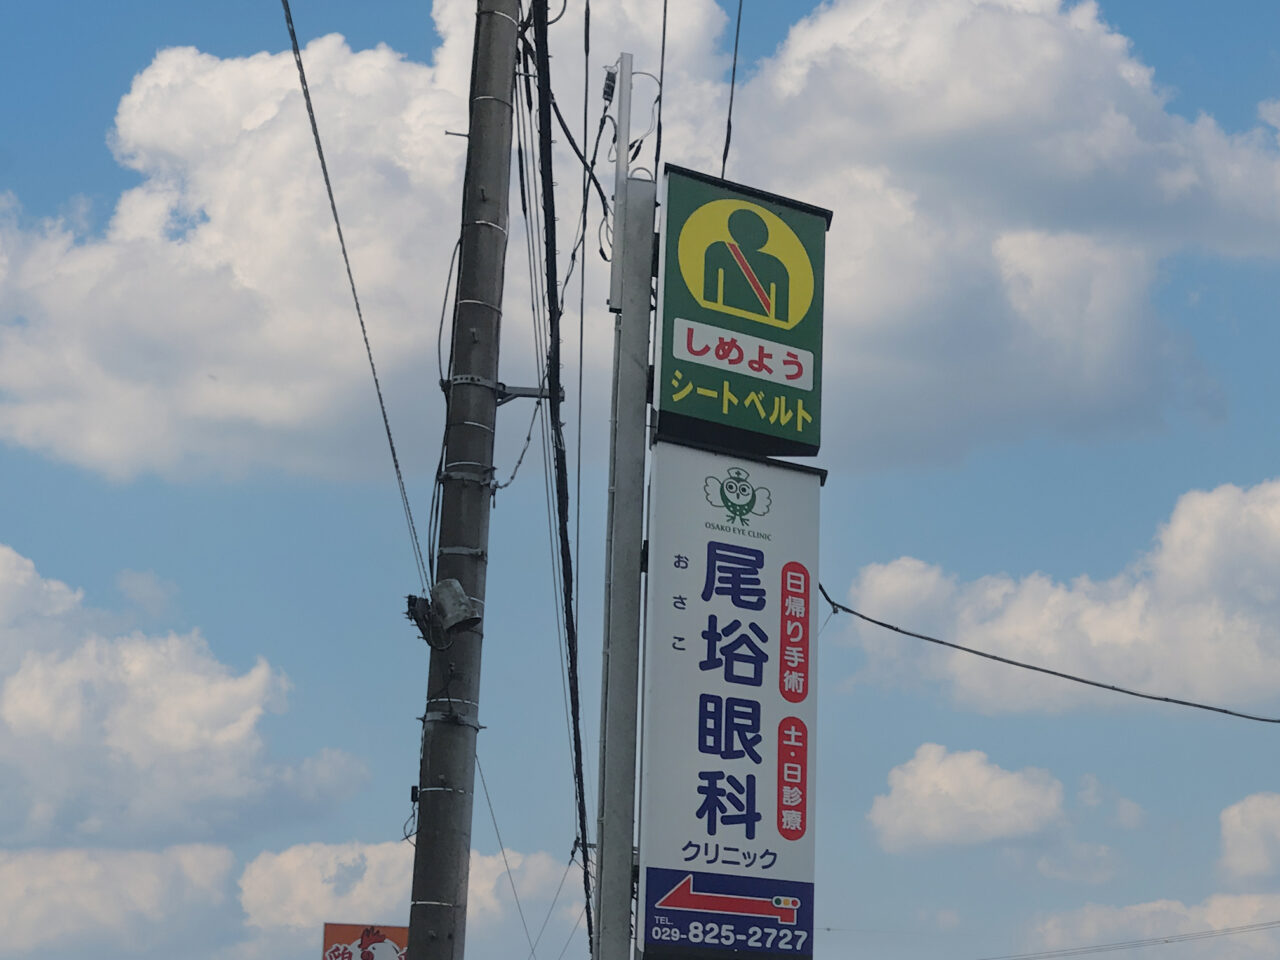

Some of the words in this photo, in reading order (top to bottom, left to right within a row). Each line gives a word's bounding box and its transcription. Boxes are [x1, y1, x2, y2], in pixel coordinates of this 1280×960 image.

[686, 328, 804, 380] しめよう
[671, 370, 812, 432] シートベルト
[705, 522, 732, 533] OSAKO
[733, 527, 746, 537] EYE
[748, 530, 772, 541] CLINIC
[672, 554, 689, 651] おさこ
[783, 571, 806, 694] 日帰り手術
[682, 841, 777, 869] クリニック
[651, 921, 808, 950] 029-825-2727
